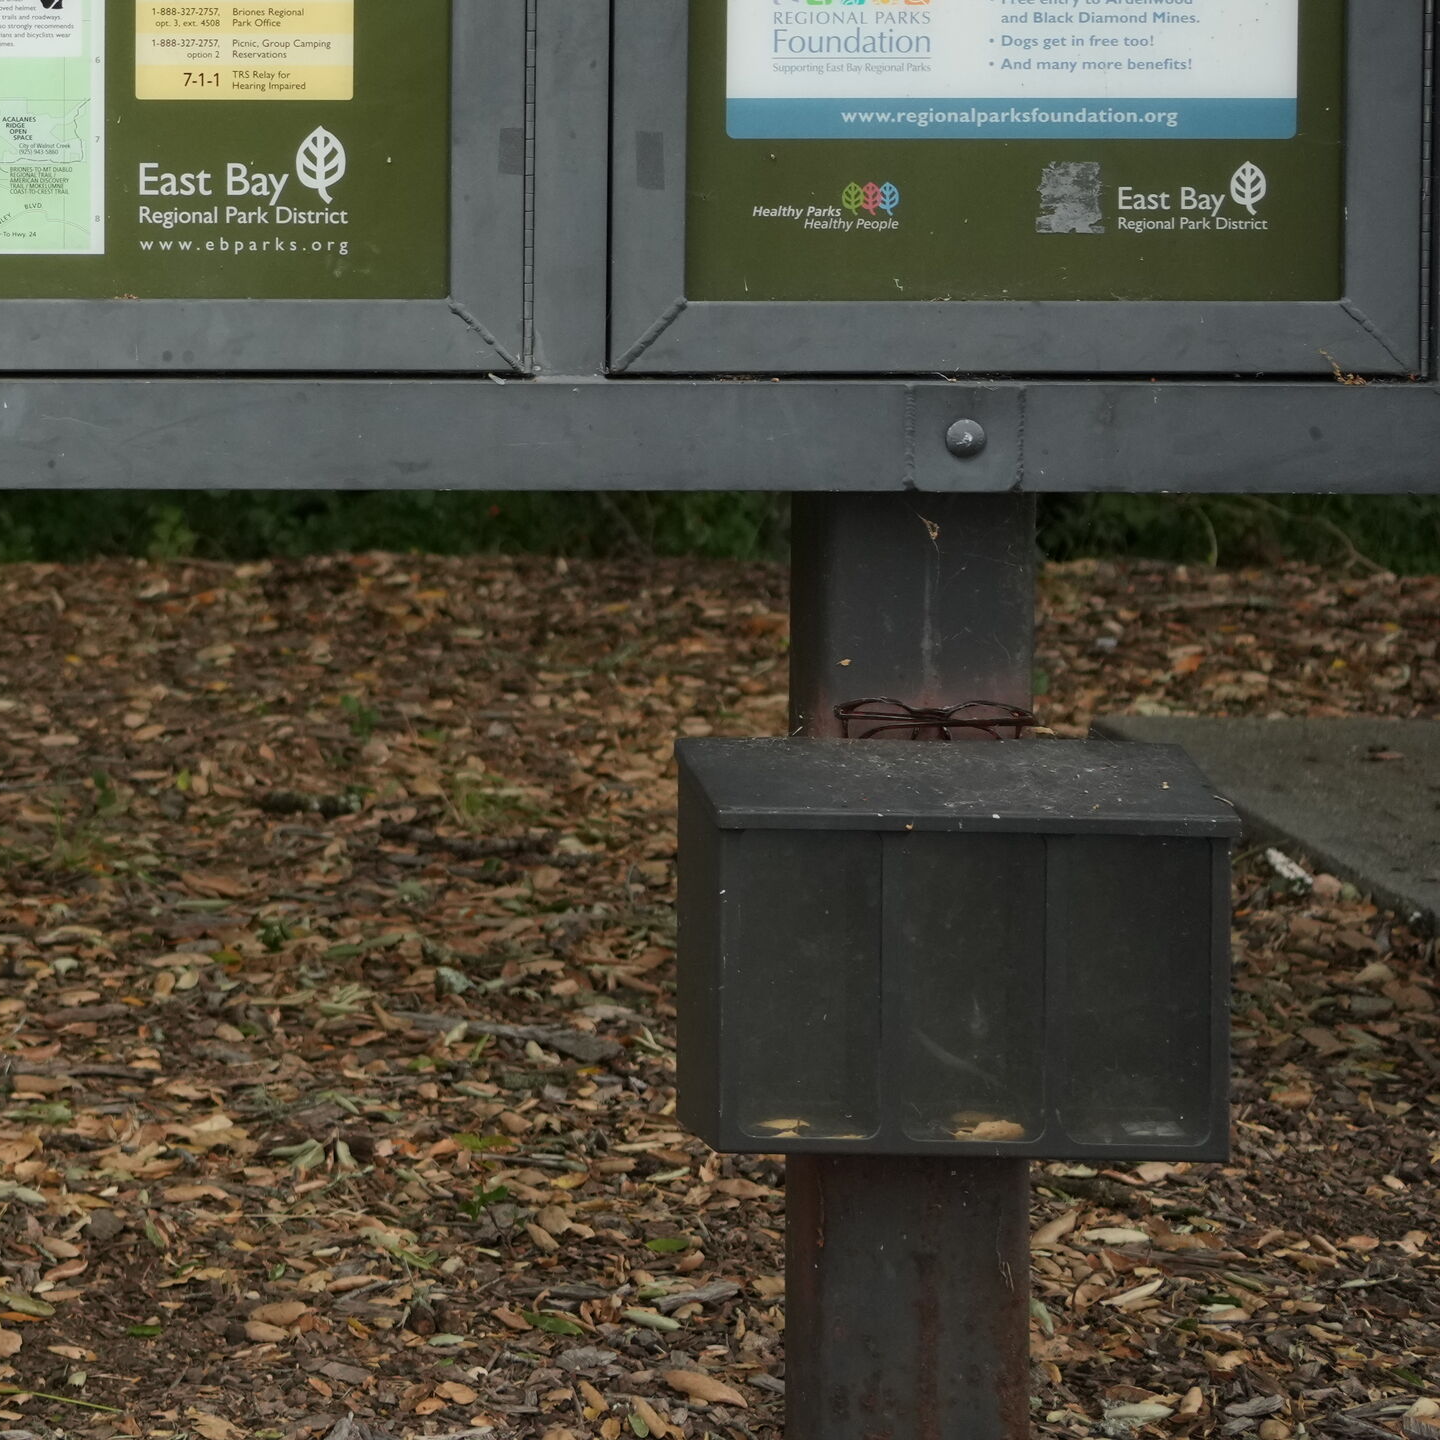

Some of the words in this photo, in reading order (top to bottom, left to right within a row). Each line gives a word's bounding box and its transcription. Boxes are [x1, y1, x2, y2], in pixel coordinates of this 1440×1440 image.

[773, 10, 868, 25] REGIONAL
[875, 10, 931, 25] PARKS
[773, 26, 931, 54] Foundation
[183, 72, 219, 87] 7-1-1
[840, 107, 1179, 129] www.regionalparksfoundation.org
[138, 162, 213, 196] East
[226, 161, 290, 207] Bay
[1118, 186, 1171, 210] East
[1180, 186, 1226, 217] Bay
[139, 205, 218, 229] Regional
[225, 205, 270, 224] Park
[275, 206, 349, 225] District
[752, 205, 804, 220] Healthy
[806, 205, 842, 220] Parks
[803, 217, 854, 233] Healthy
[855, 217, 899, 232] People
[1117, 216, 1175, 234] Regional
[1179, 215, 1215, 230] Park
[1215, 216, 1269, 230] District
[139, 236, 349, 256] www.ebparks.org
